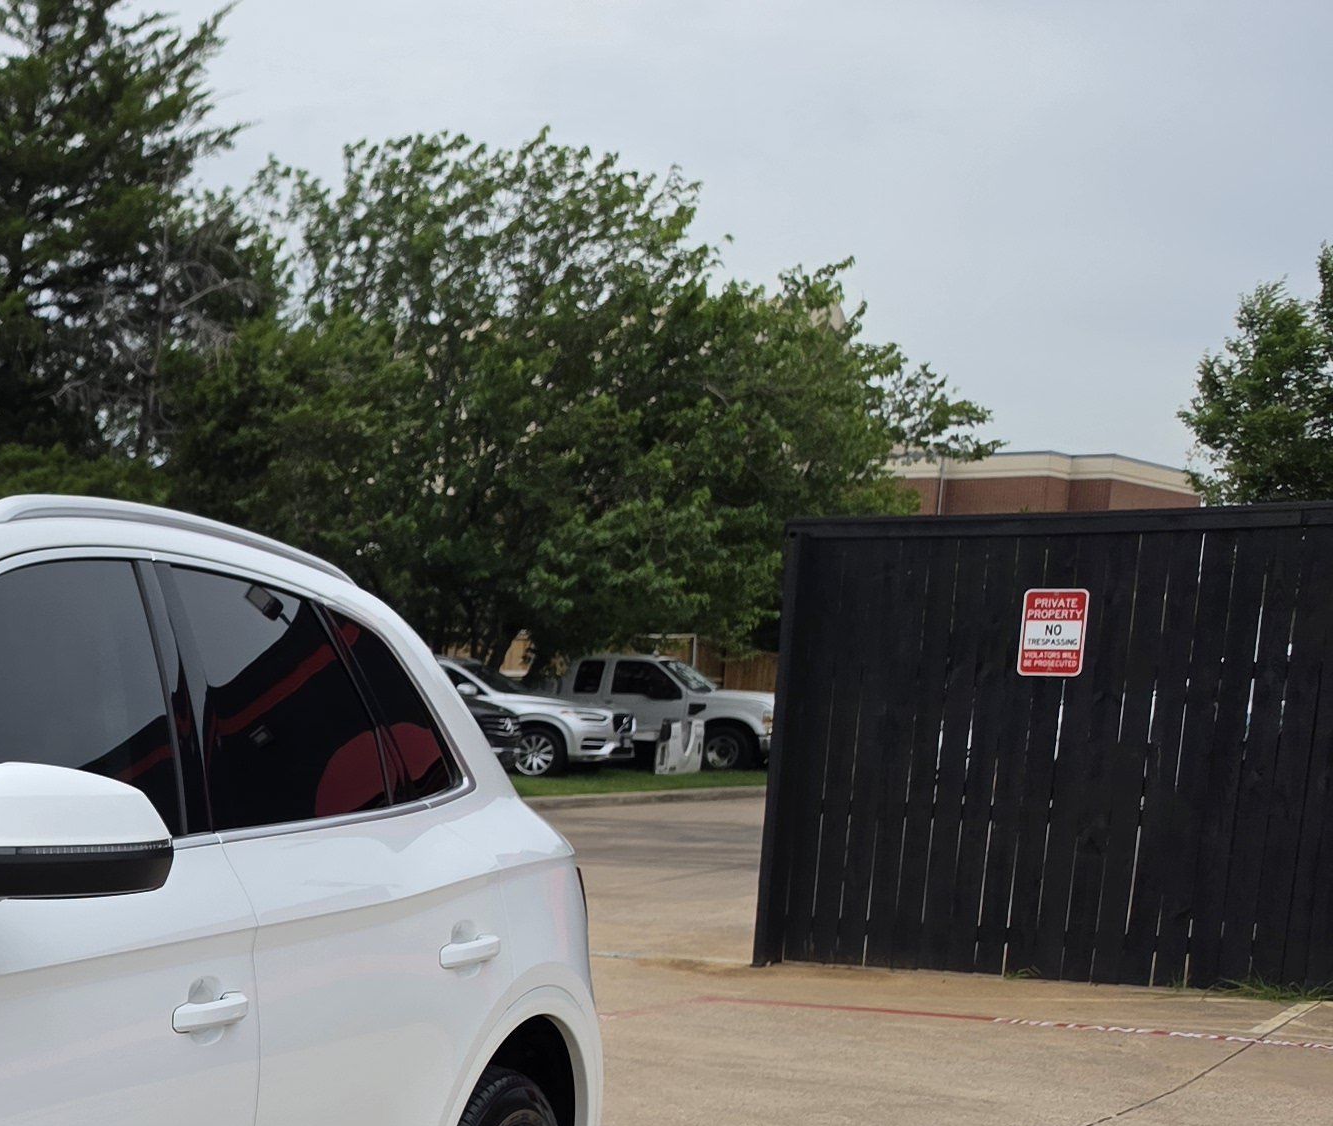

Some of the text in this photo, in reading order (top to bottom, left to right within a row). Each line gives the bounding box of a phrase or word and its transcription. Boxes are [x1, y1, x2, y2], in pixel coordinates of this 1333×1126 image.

[1034, 598, 1078, 608] PRIVATE
[1027, 609, 1083, 619] PROPERTY
[1045, 624, 1062, 636] NO
[1024, 651, 1061, 659] VIOLATORS
